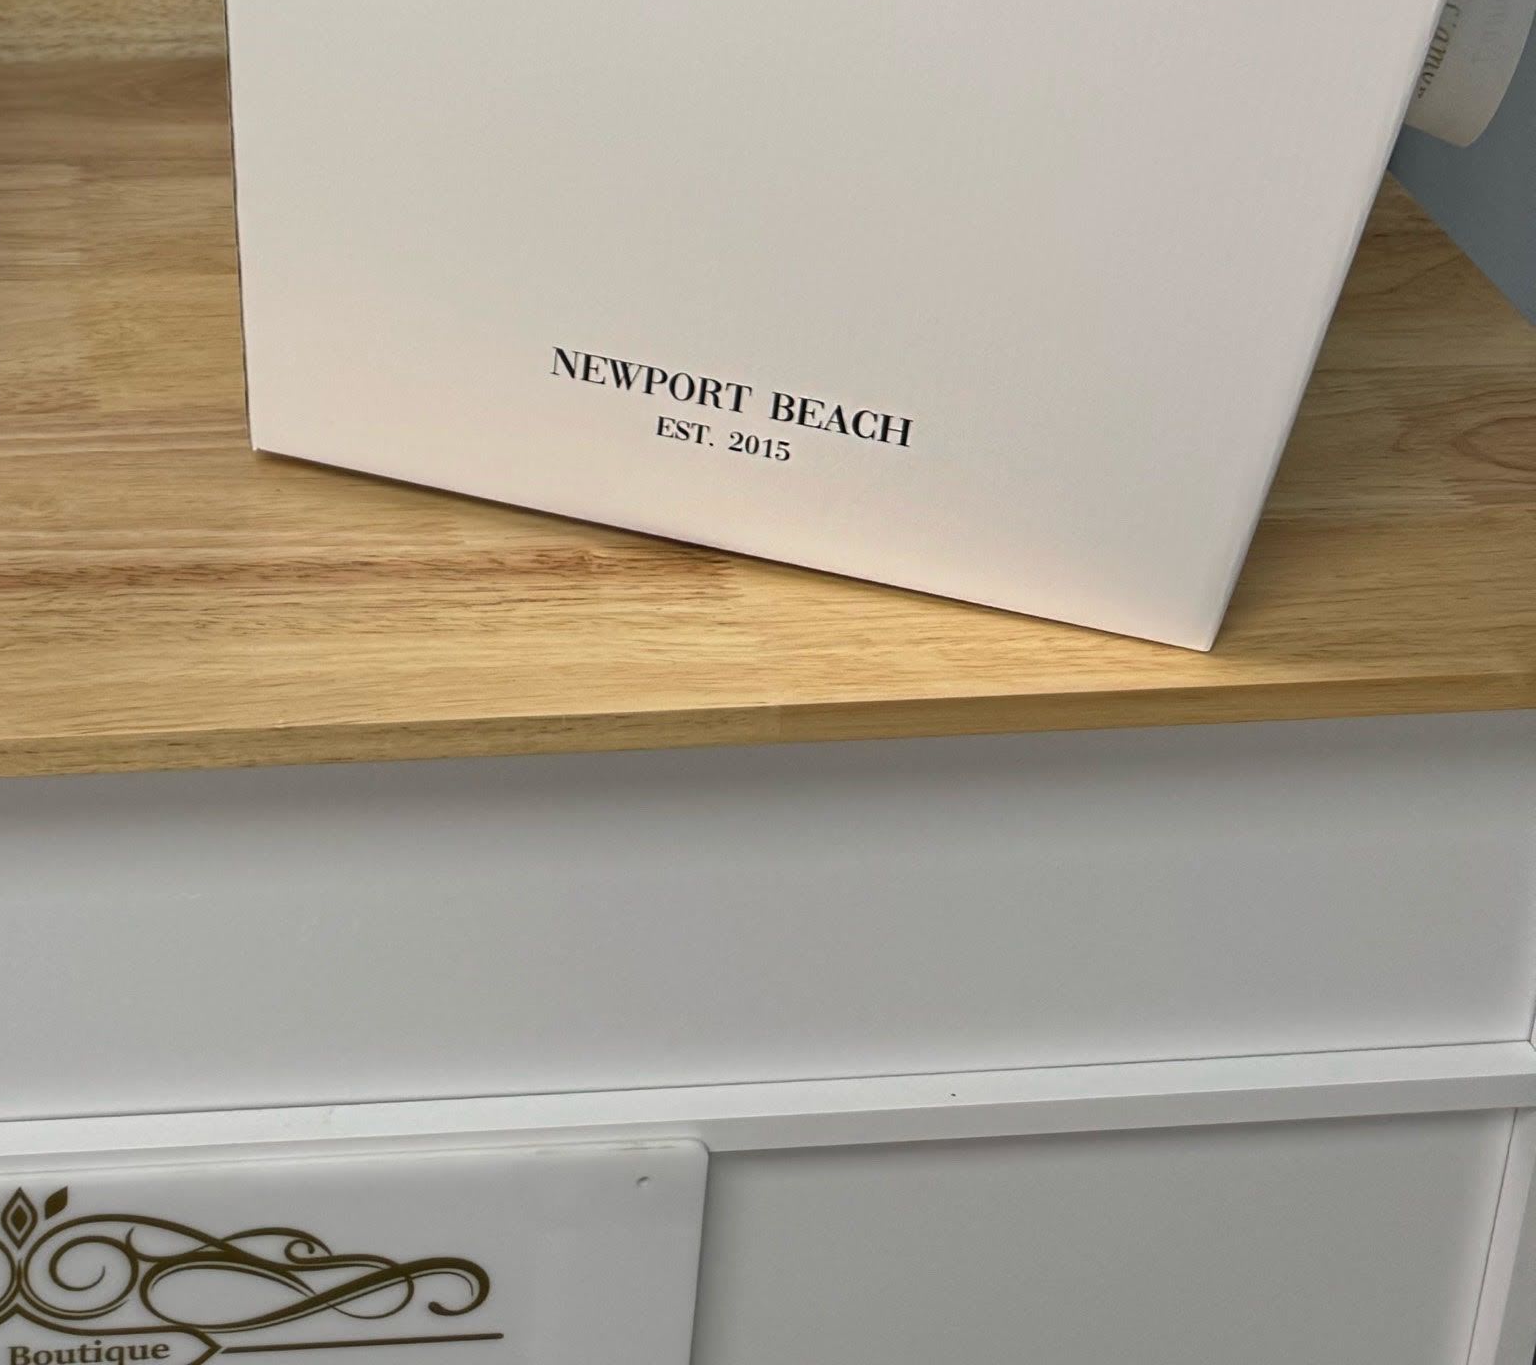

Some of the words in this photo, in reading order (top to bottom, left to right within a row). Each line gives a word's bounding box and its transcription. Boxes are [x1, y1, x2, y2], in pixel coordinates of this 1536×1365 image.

[550, 345, 753, 414] NEWPORT
[768, 391, 915, 448] BEACH
[655, 415, 715, 447] EST.
[727, 430, 792, 462] 2015
[7, 1339, 171, 1365] Boutique
